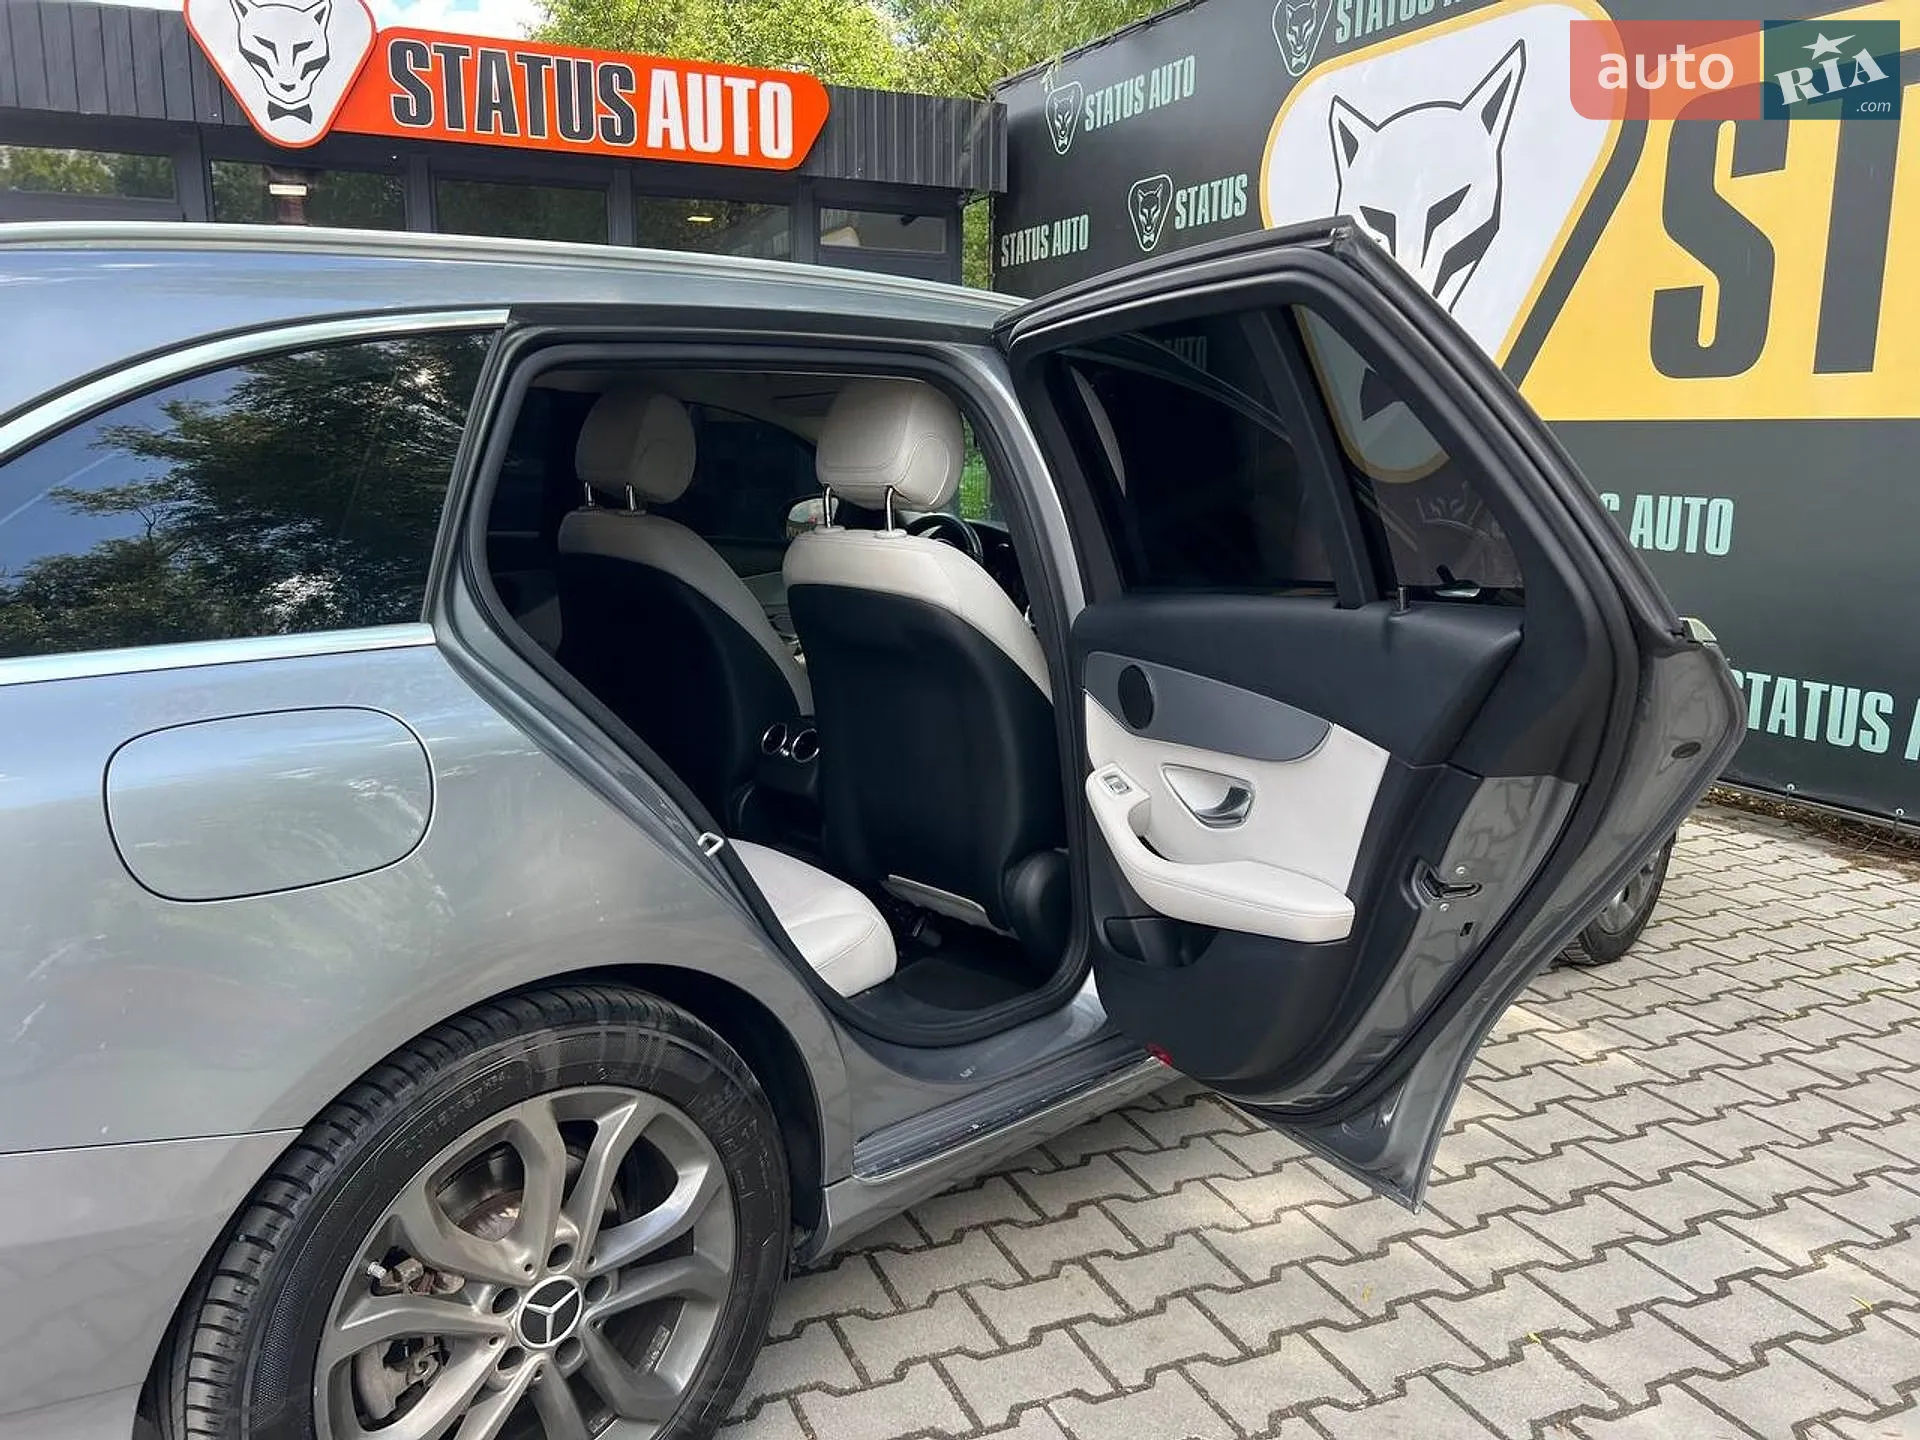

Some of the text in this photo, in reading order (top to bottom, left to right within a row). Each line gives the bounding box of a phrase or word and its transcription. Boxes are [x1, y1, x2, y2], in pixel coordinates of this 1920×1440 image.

[1335, 0, 1434, 44] STAT
[388, 38, 794, 160] STATUS AUTO
[1084, 55, 1196, 132] STATUS AUTO
[1174, 173, 1248, 230] STATUS
[1000, 214, 1090, 268] STATUS AUTO
[1629, 494, 1734, 556] AUTO
[1729, 669, 1894, 754] TATUS
